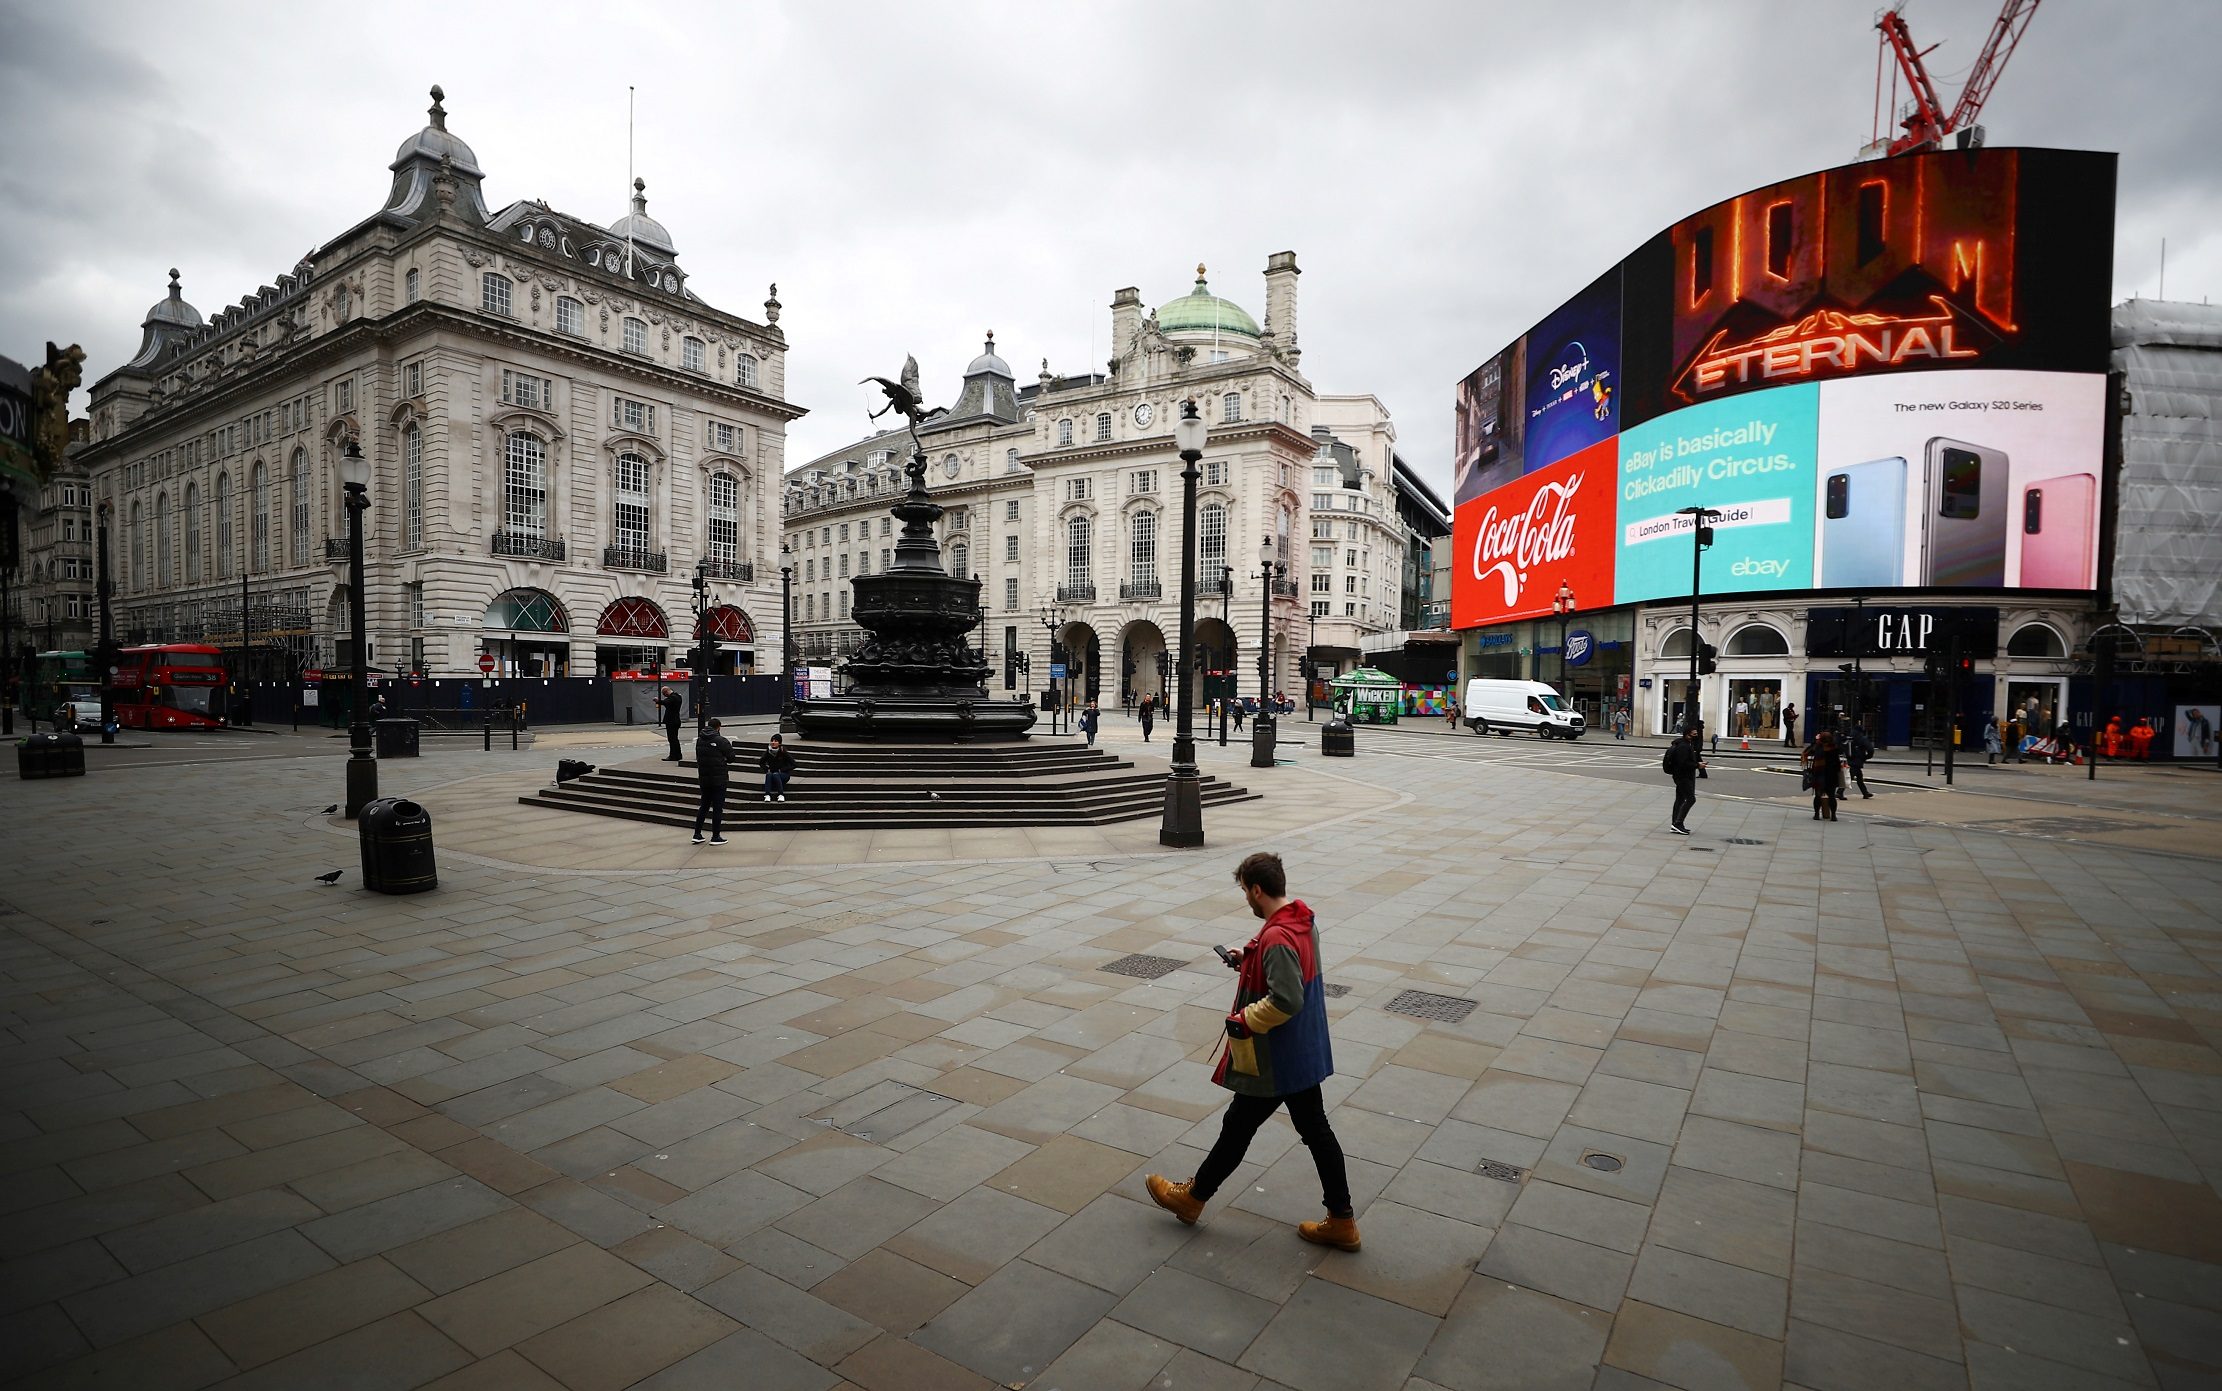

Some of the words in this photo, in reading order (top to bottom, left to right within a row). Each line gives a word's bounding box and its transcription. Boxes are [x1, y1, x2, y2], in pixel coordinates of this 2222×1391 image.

[1673, 149, 2018, 372] DOOM
[1695, 325, 1978, 393] ETERNAL
[1894, 403, 1916, 412] The
[1919, 402, 1946, 410] new
[1948, 400, 1990, 412] Galaxy
[1992, 400, 2010, 410] S20
[2012, 401, 2044, 411] Series
[1625, 449, 1657, 473] eBay
[1660, 442, 1674, 462] is
[1677, 420, 1777, 457] basically
[1624, 465, 1704, 501] Clickadilly
[1707, 453, 1797, 480] Circus.
[1473, 467, 1586, 607] Coca-Cola
[1639, 521, 1670, 537] London
[1672, 515, 1705, 530] Travl
[1708, 508, 1748, 524] Guide
[1731, 557, 1790, 577] ebay
[1565, 636, 1588, 660] Boots
[1878, 614, 1933, 649] GAP
